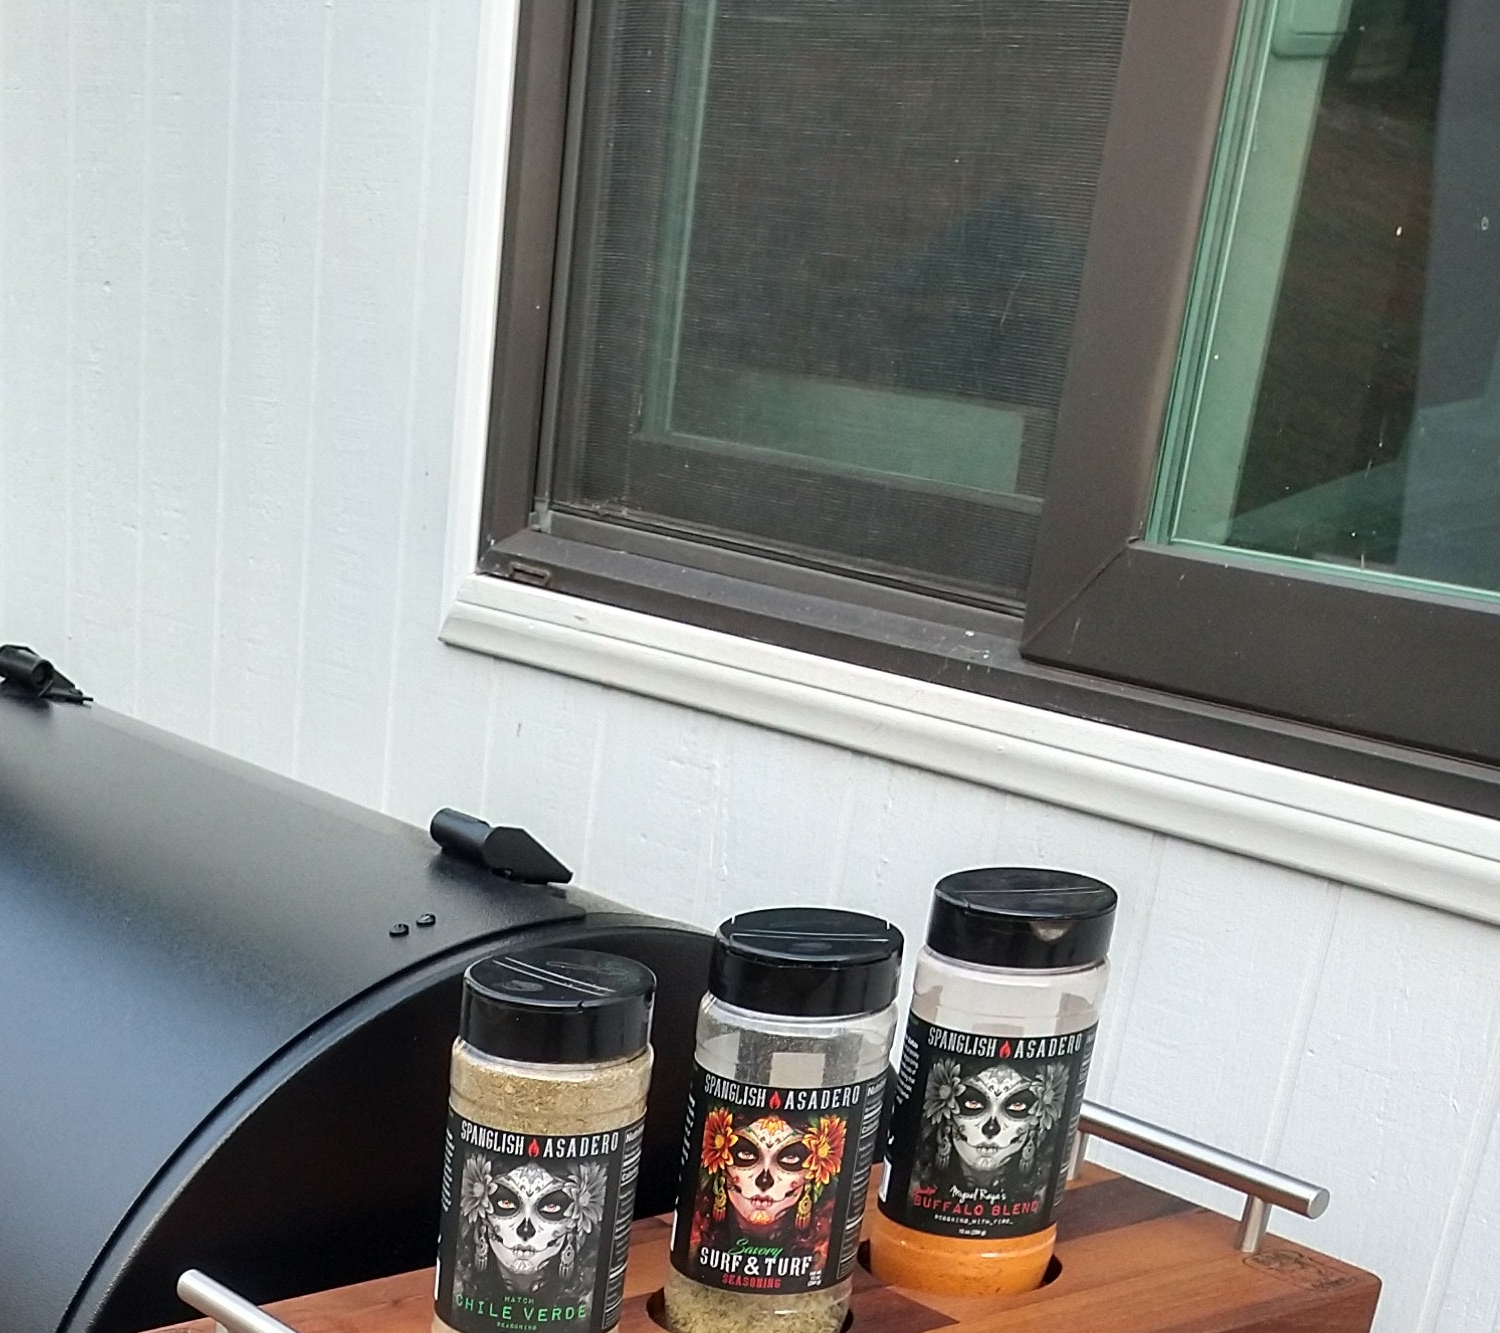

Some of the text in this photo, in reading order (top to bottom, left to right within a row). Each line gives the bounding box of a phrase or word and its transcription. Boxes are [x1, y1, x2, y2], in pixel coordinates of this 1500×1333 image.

[927, 1026, 997, 1058] SPANGLISH
[1013, 1033, 1083, 1060] ASADERO
[704, 1073, 766, 1108] SPANGLISH
[785, 1084, 861, 1111] ASADERO
[460, 1120, 525, 1156] SPANGLISH
[542, 1131, 619, 1159] ASADERO
[913, 1195, 1040, 1217] BUFFALO BLEND
[699, 1246, 813, 1277] SURF & TURF
[728, 1238, 784, 1258] Savory
[721, 1273, 782, 1289] SEASONING
[456, 1294, 587, 1322] CHILE VERDE
